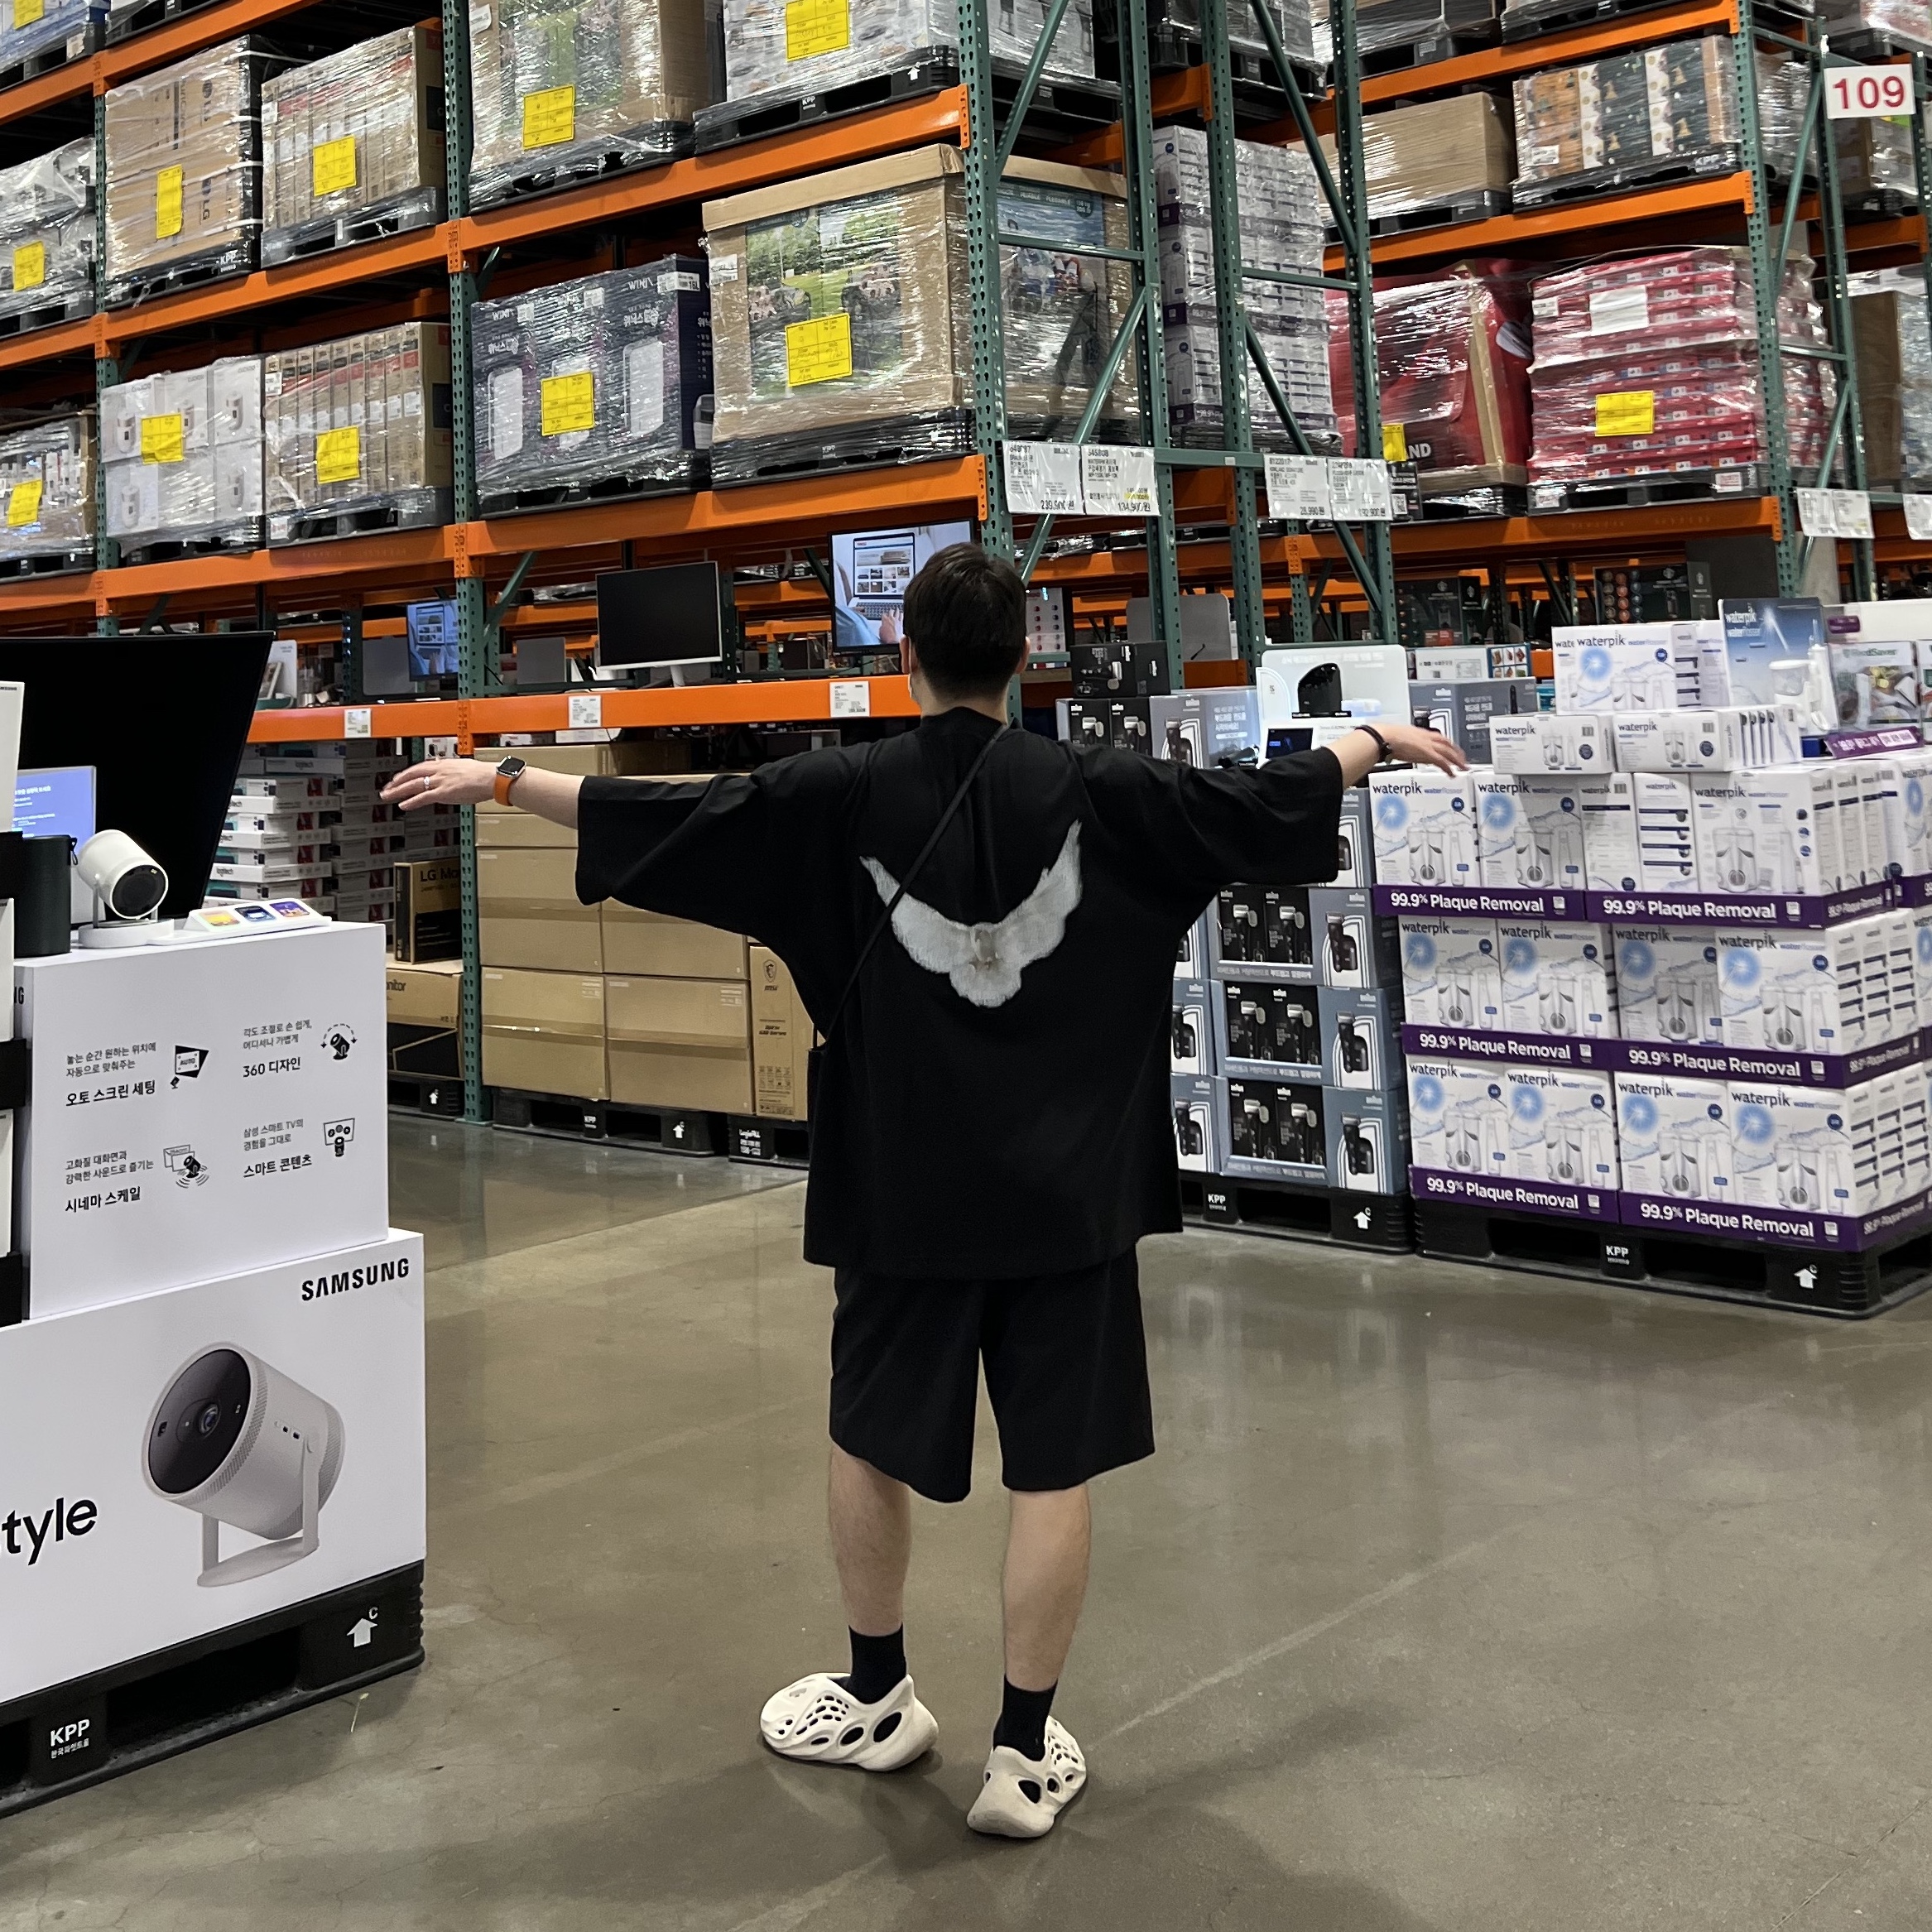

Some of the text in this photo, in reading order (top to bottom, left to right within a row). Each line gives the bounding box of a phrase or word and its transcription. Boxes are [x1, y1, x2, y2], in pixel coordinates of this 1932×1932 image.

[1833, 75, 1905, 109] 109
[1725, 611, 1757, 625] waterpik
[1577, 635, 1626, 647] waterpik
[1496, 724, 1536, 736] waterpik
[1618, 723, 1658, 733] waterpik
[1372, 781, 1422, 795] waterpik
[1478, 781, 1531, 795] waterpik
[1694, 786, 1747, 799] waterpik
[420, 869, 436, 882] LG
[1391, 892, 1544, 912] 99.9% Plaque Removal
[1603, 899, 1776, 919] 99.9% Plaque Removal
[1402, 919, 1449, 935] waterpik
[1501, 923, 1552, 940] waterpik
[1616, 927, 1670, 943] waterpik
[1719, 935, 1776, 949] waterpik
[243, 1027, 258, 1037] 각도
[261, 1023, 284, 1035] 조절로
[286, 1022, 293, 1031] 손
[243, 1034, 299, 1050] 어디서나 가볍게
[1420, 1034, 1571, 1060] 99.9% Plaque Removal
[66, 1041, 156, 1065] 놓는 순간 원하는 위치에
[66, 1059, 136, 1078] 자동으로 맞춰주는
[243, 1056, 300, 1078] 360 디자인
[1411, 1060, 1459, 1077] waterpik
[1629, 1049, 1800, 1077] 99.9% Plaque Removal
[1508, 1070, 1560, 1088] waterpik
[66, 1079, 156, 1107] 오토 스크린 세팅
[1618, 1081, 1675, 1098] waterpik
[1732, 1091, 1790, 1108] waterpik
[243, 1118, 304, 1138] 삼성 스마트 TV의
[243, 1133, 291, 1151] 경험을 그대로
[65, 1151, 127, 1170] 고화질 대화면과
[243, 1154, 313, 1178] 스마트 콘텐츠
[65, 1160, 155, 1185] 강력한 사운드로 즐기는
[65, 1186, 141, 1213] 시네마 스케일
[1208, 1194, 1226, 1204] KPP
[1427, 1178, 1579, 1209] 99.9% Plaque Removal
[1641, 1203, 1814, 1238] 99.9% Plaque Removal
[1606, 1245, 1629, 1257] KPP
[301, 1257, 410, 1301] SAMSUNG
[50, 1718, 90, 1747] KPP
